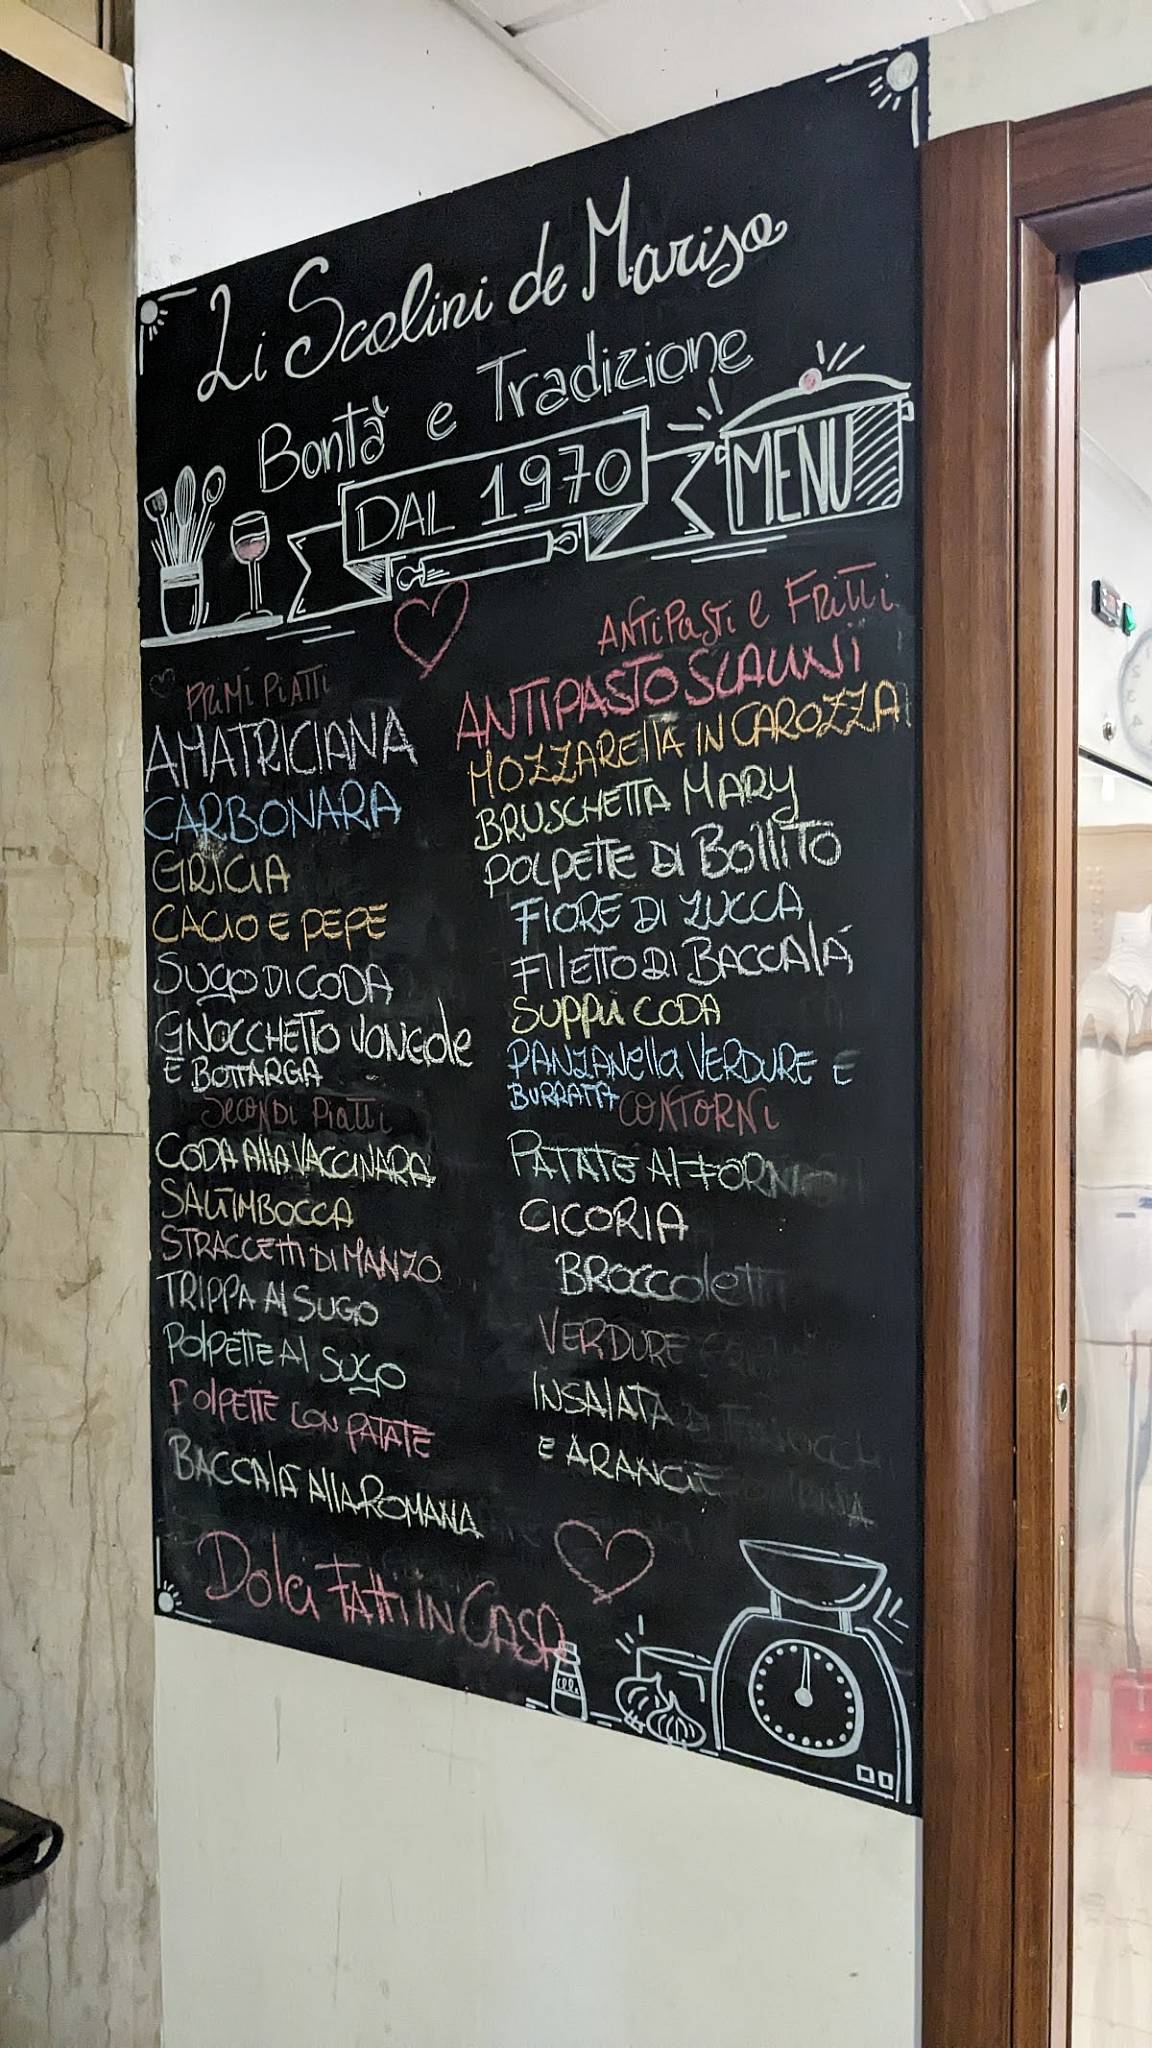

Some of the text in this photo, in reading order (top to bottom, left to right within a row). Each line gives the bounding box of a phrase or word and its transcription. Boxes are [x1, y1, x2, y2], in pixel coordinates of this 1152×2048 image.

[508, 221, 567, 314] de
[258, 329, 753, 493] Bontà e Tradizione
[734, 410, 853, 527] MENU
[355, 444, 632, 552] DAL 1970
[457, 652, 679, 751] ANTIPASTO
[144, 706, 419, 792] AMATRICIANA
[697, 712, 724, 757] IN
[144, 780, 402, 845] CARBONARA
[474, 761, 798, 850] BRUSCHETTA MARY
[152, 850, 290, 896] GRICIA
[649, 840, 685, 878] DI
[269, 911, 290, 941] E
[510, 881, 804, 945] FIORE DI ZUCCA
[263, 965, 291, 998] DI
[155, 1009, 340, 1056] GNOCCHETTO
[687, 1032, 819, 1086] VERDURE
[163, 1056, 185, 1085] E
[519, 1196, 689, 1245] CICORIA
[310, 1244, 338, 1272] DI
[344, 1237, 442, 1283] MANZO
[157, 1270, 256, 1316] TRIPPA
[293, 1285, 379, 1327] SUGO
[538, 1306, 690, 1369] VERDURE
[346, 1412, 436, 1460] PATATE
